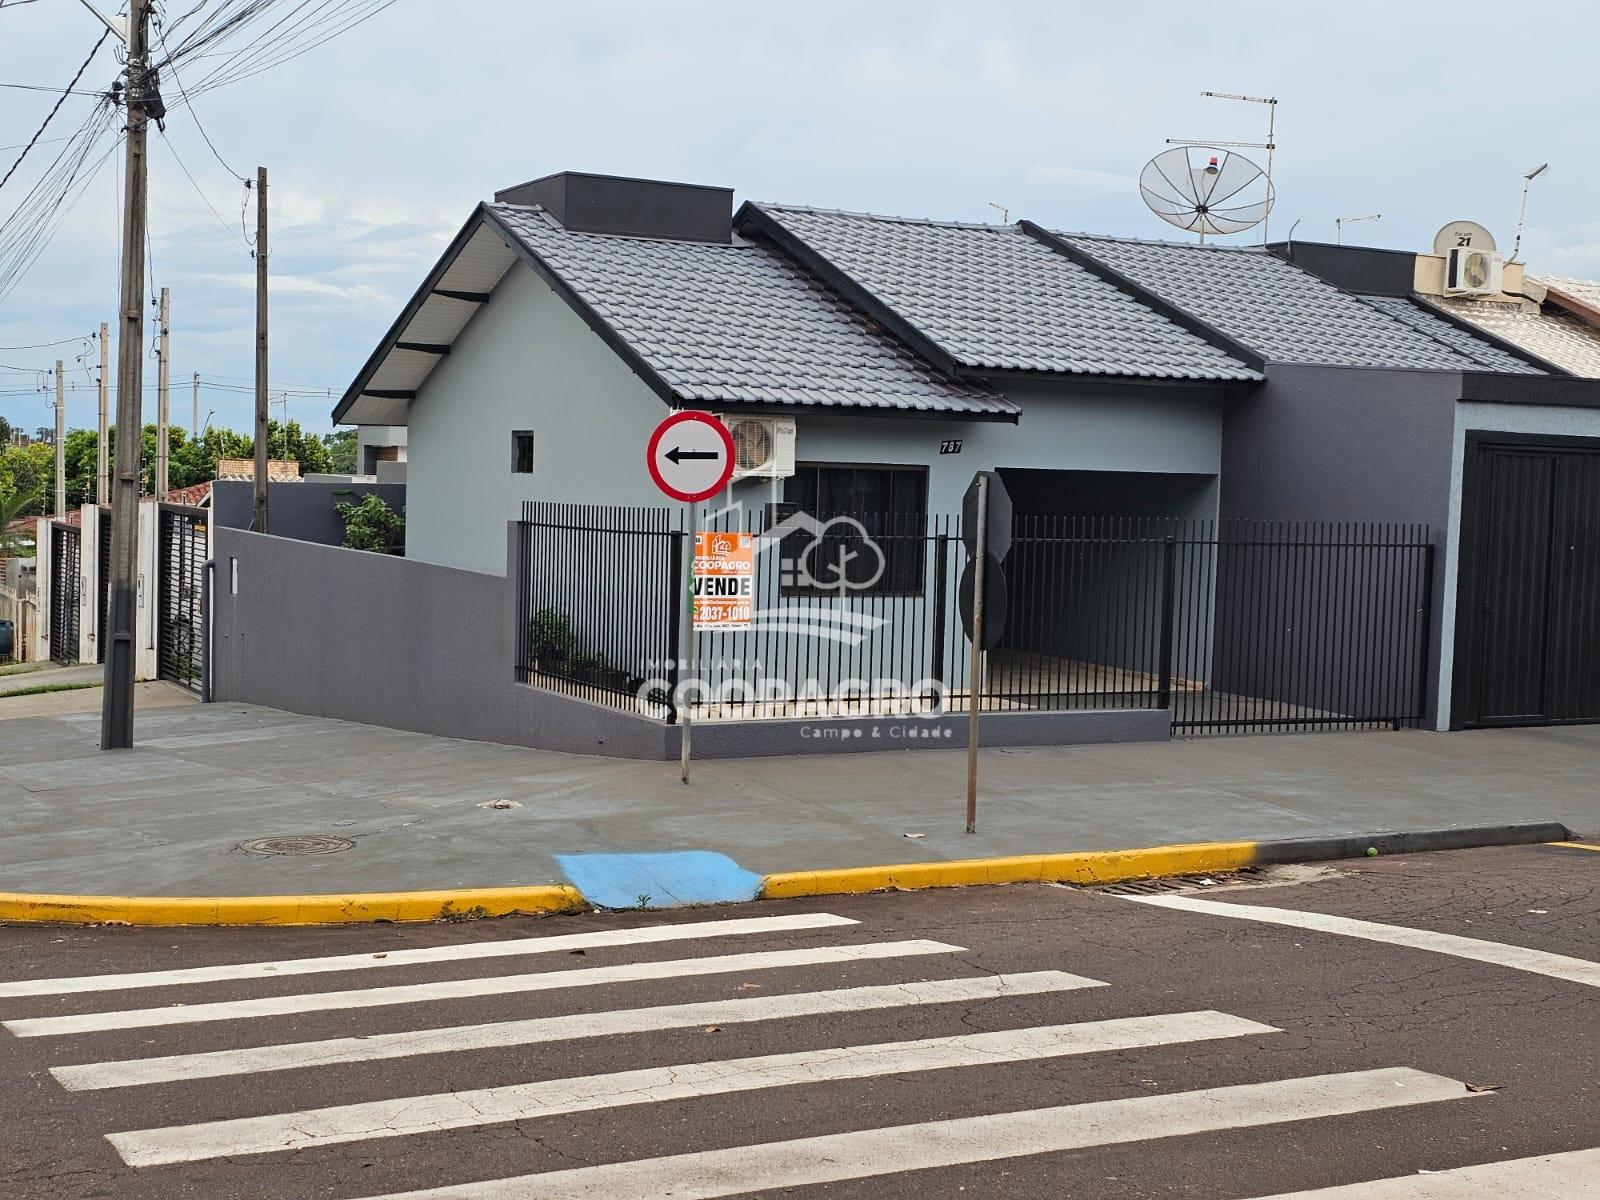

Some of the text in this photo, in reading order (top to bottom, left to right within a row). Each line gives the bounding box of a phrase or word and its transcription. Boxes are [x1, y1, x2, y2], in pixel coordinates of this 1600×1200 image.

[1457, 237, 1471, 247] 21
[941, 441, 962, 453] 787
[691, 560, 751, 570] COOPAGRO
[693, 577, 750, 596] VENDE
[699, 605, 750, 621] 2037-1010
